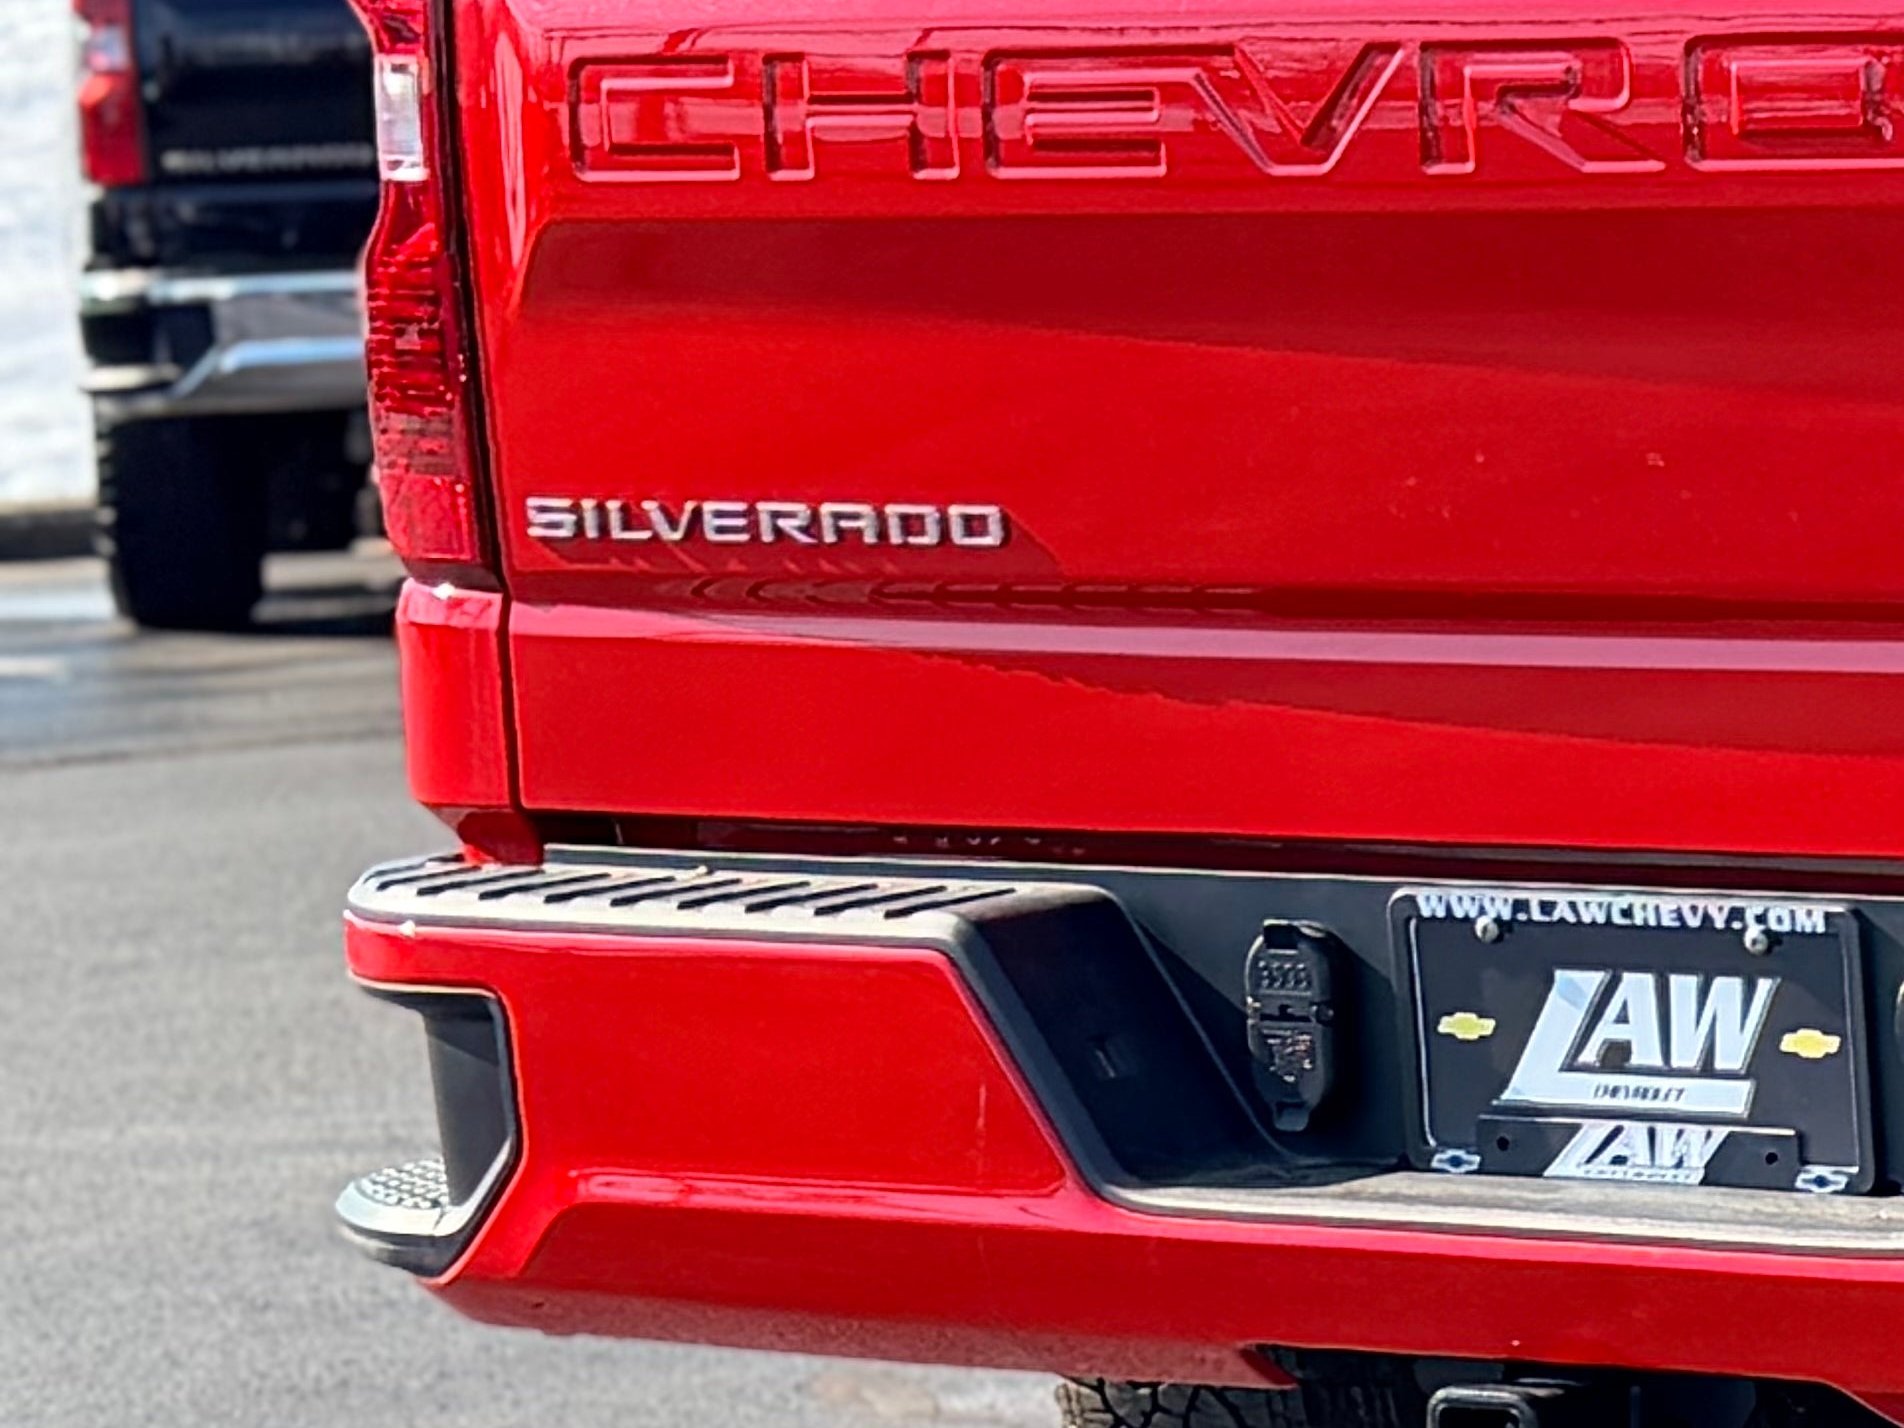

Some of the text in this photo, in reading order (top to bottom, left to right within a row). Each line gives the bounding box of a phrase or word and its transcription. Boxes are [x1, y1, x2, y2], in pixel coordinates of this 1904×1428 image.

[524, 496, 1006, 548] SILVERADO
[1415, 892, 1827, 934] WWW.LAWCHEVY.COM
[1493, 968, 1782, 1116] LAW
[1543, 1121, 1729, 1184] LAW
